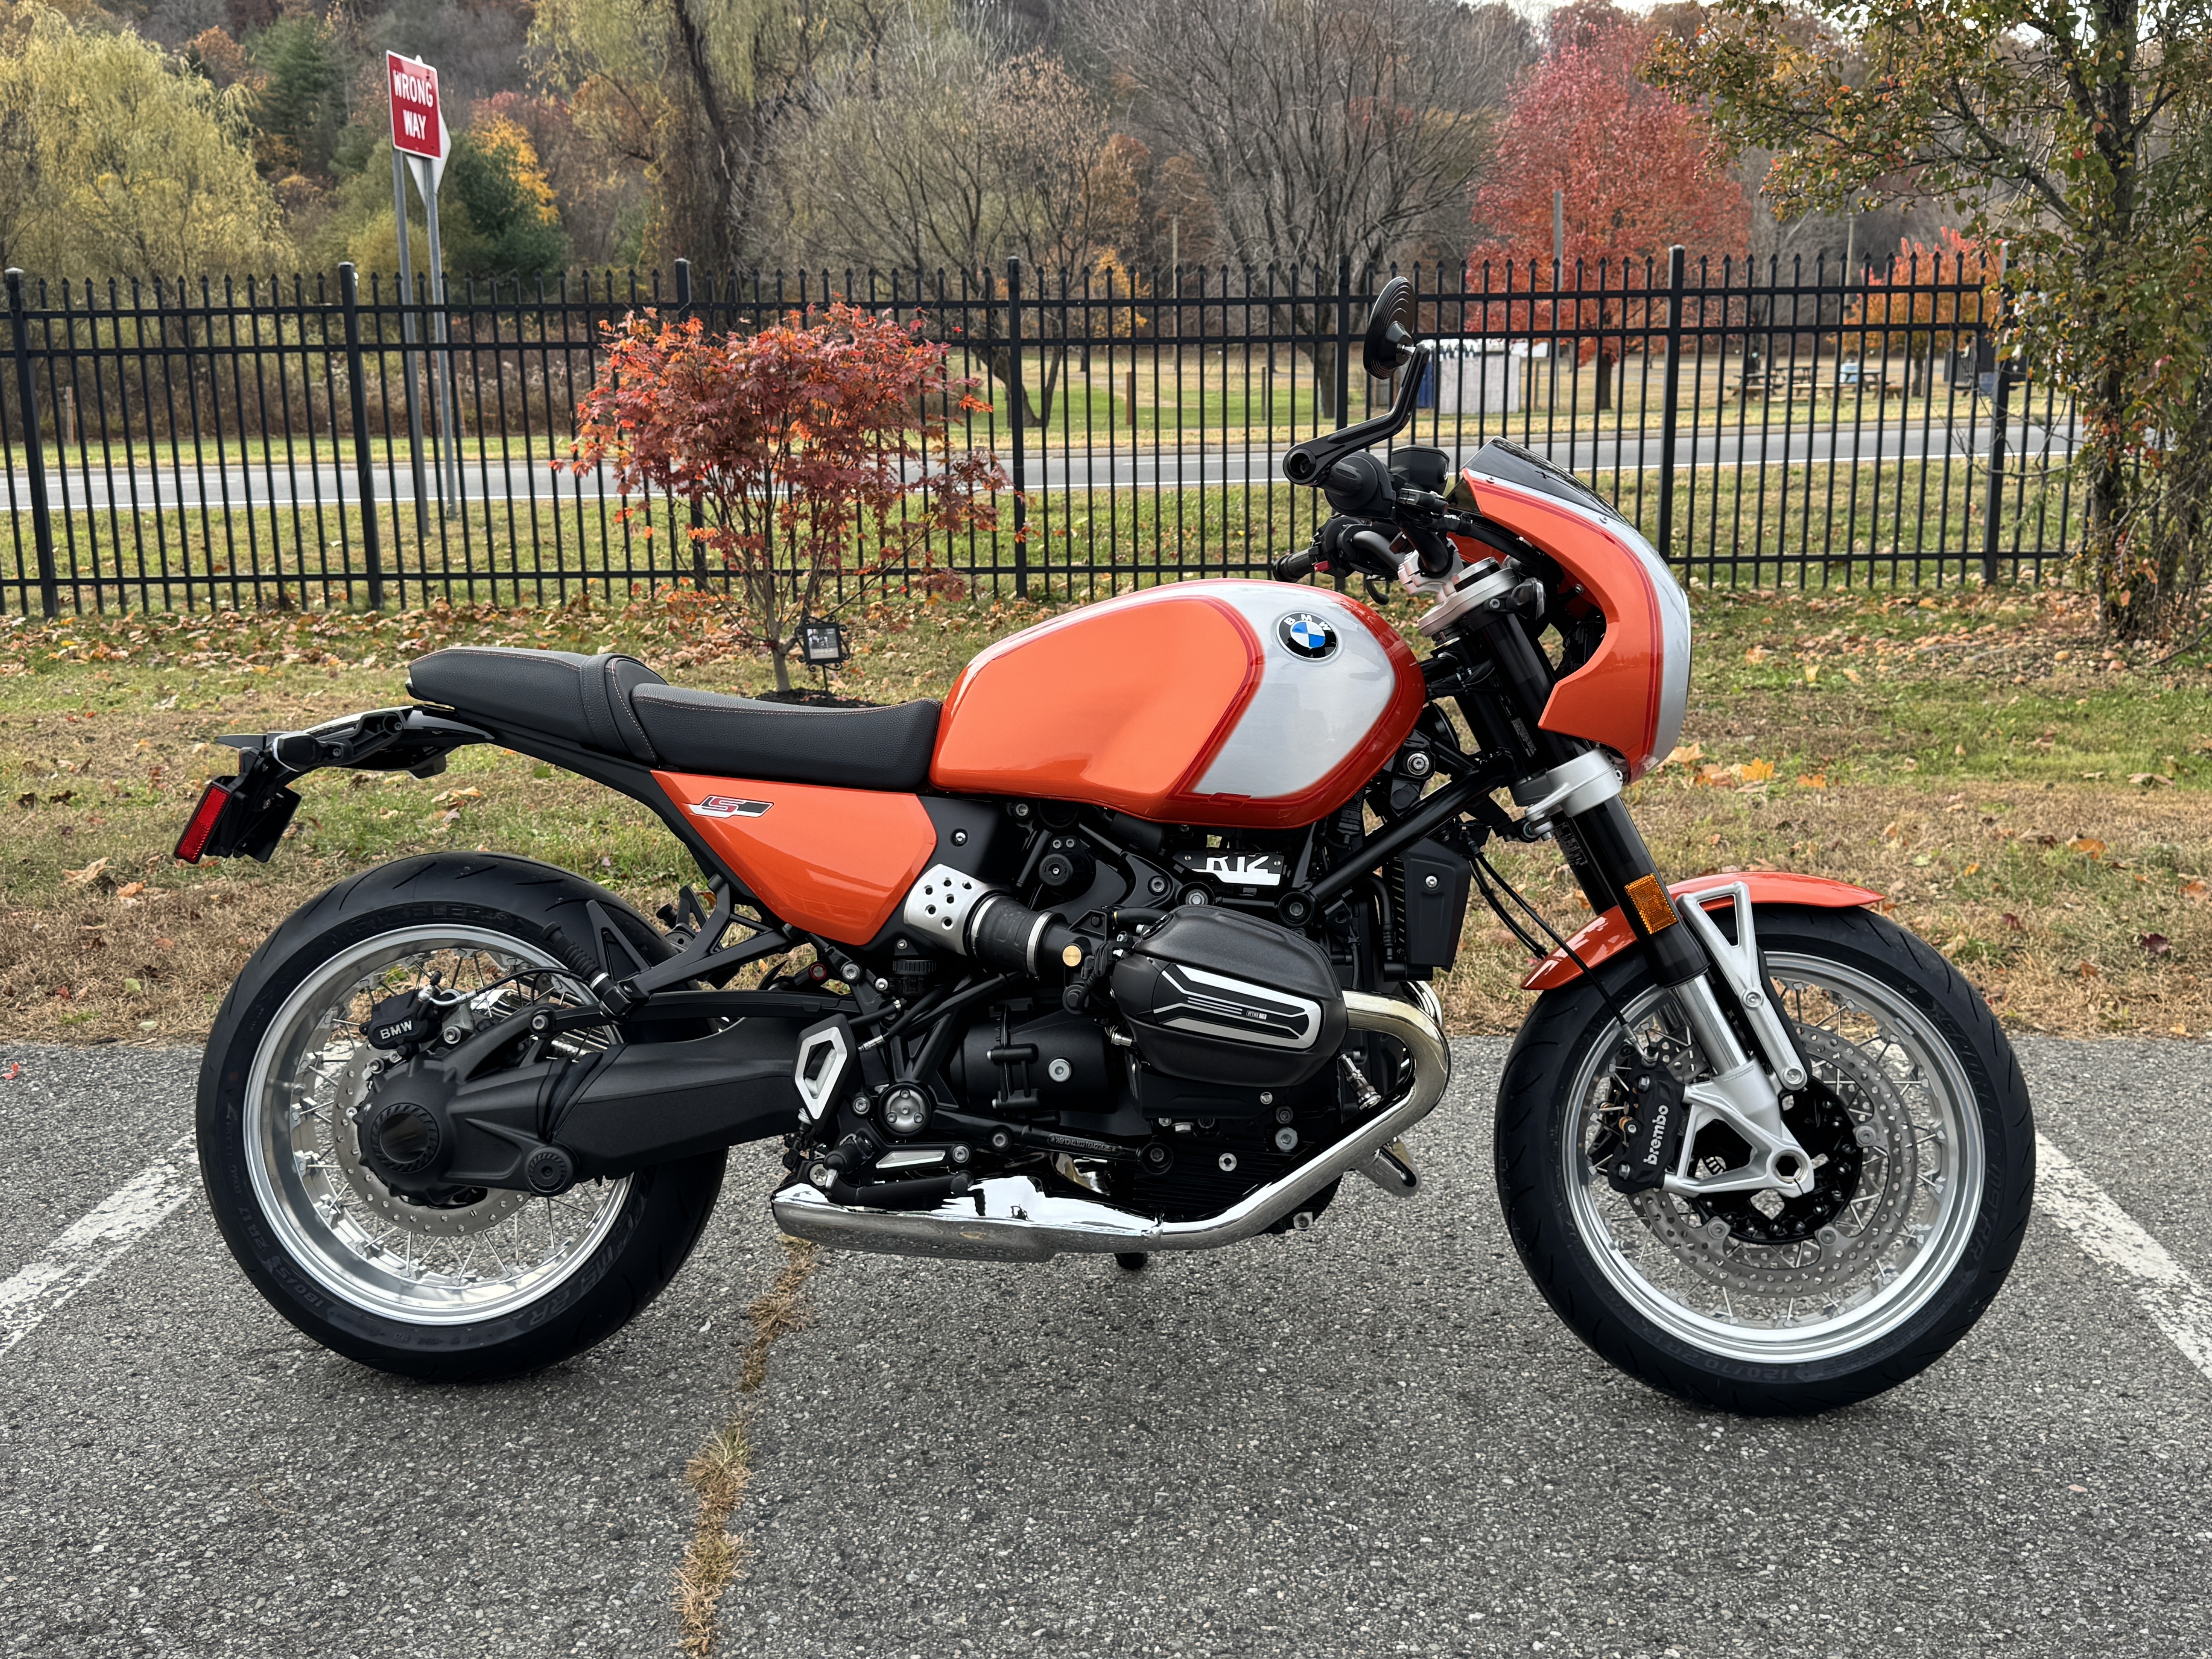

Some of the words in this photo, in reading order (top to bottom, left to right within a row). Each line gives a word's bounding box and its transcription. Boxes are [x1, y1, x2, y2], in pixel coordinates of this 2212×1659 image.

[393, 70, 433, 107] WRONG
[403, 110, 426, 140] WAY
[1284, 614, 1331, 631] BMW
[380, 1020, 412, 1040] BMW
[1643, 1104, 1669, 1165] brembo
[1702, 1357, 1790, 1379] 120/70
